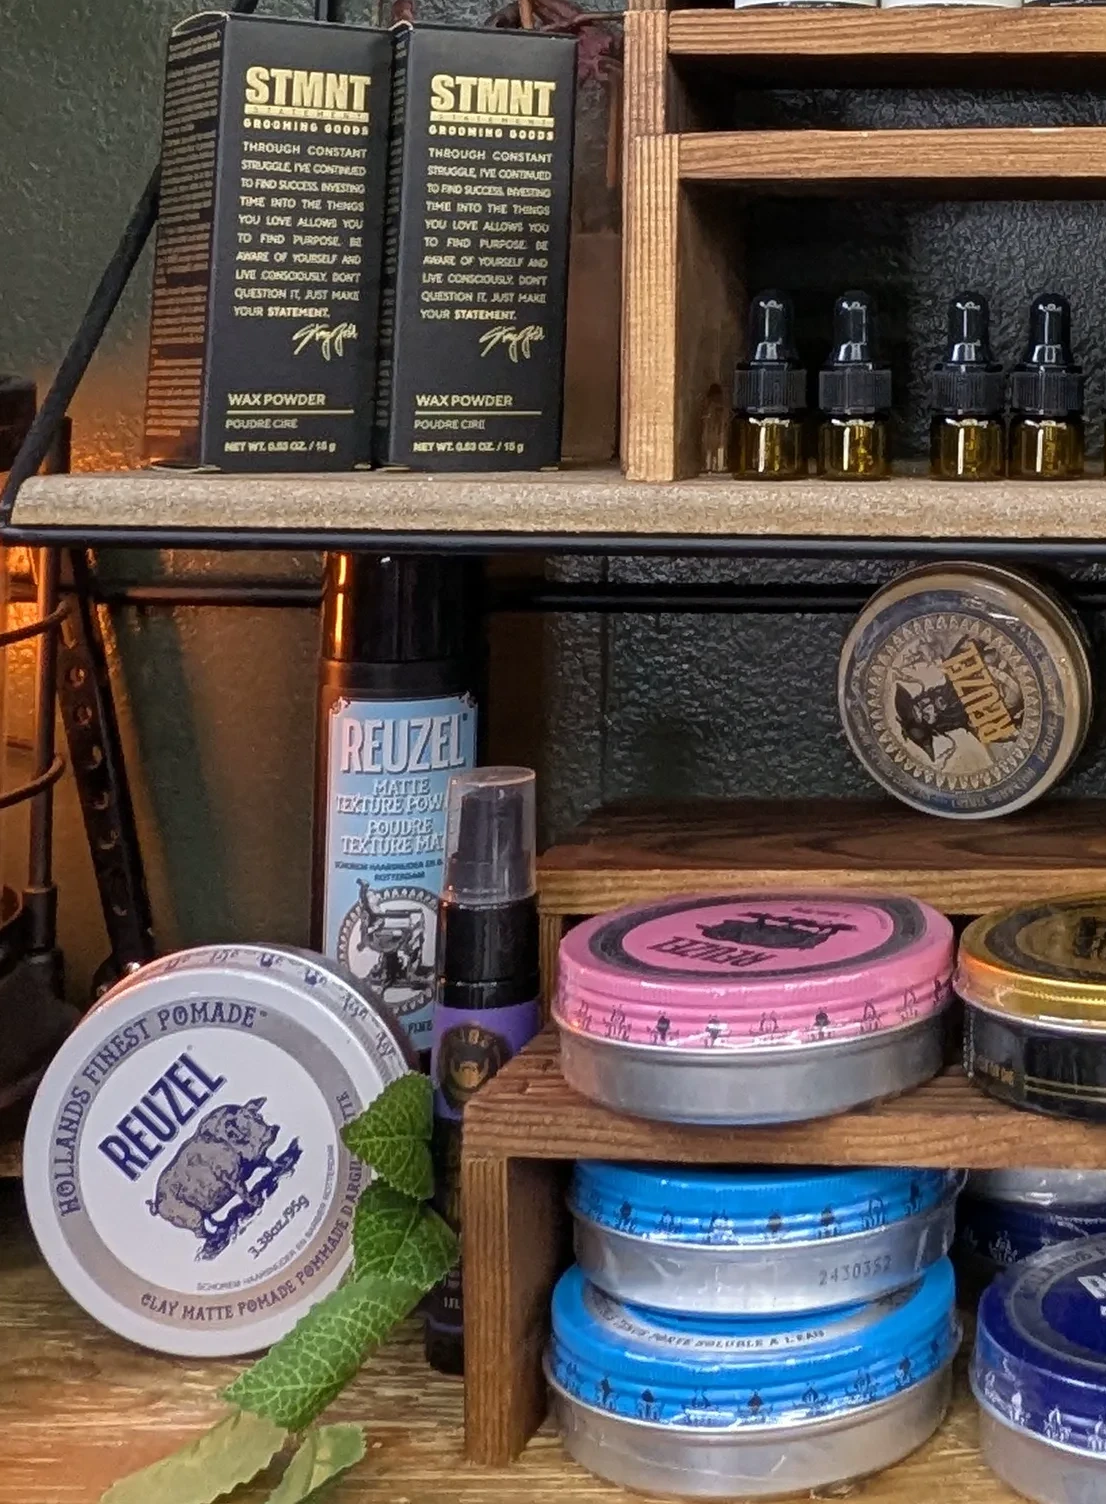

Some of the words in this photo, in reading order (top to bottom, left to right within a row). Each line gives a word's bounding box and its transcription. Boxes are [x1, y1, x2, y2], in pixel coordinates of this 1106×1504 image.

[246, 67, 371, 110] STMNT
[431, 74, 556, 116] STMNT
[243, 118, 318, 132] GROOMING
[324, 124, 368, 135] GOODS
[429, 125, 503, 138] GROOMING
[510, 130, 554, 141] GOODS
[243, 141, 300, 154] THROUGH
[307, 146, 367, 158] CONSTANT
[428, 148, 486, 160] THROUGH
[492, 151, 552, 163] CONSTANT
[313, 164, 366, 176] CONTINUED
[241, 178, 253, 188] TO
[255, 179, 276, 189] FIND
[240, 196, 265, 207] TIME
[271, 198, 296, 208] INTO
[302, 199, 322, 210] THE
[327, 200, 364, 211] THINGS
[239, 214, 260, 224] YOU
[266, 216, 292, 226] LOVE
[298, 217, 337, 228] ALLOWS
[343, 219, 363, 229] YOU
[238, 233, 252, 243] TO
[260, 233, 285, 244] FIND
[236, 252, 269, 262] AWARE
[274, 252, 288, 262] OF
[292, 254, 337, 264] YOURSELF
[342, 255, 361, 265] AND
[236, 269, 256, 280] LIVE
[235, 288, 286, 299] QUESTION
[305, 290, 328, 300] JUST
[332, 291, 360, 301] MAKE
[234, 306, 263, 316] YOUR
[228, 394, 262, 406] WAX
[264, 394, 326, 406] POWDER
[416, 394, 449, 406] WAX
[451, 395, 513, 406] POWDER
[225, 419, 271, 428] POUDRE
[225, 442, 246, 452] NET
[942, 636, 1020, 745] REUZEL
[340, 713, 465, 775] REUZEL
[373, 777, 431, 797] MATTE
[337, 794, 404, 815] TEXTURE
[368, 818, 434, 838] POUDRE
[341, 835, 413, 857] TEXTURE
[646, 936, 778, 967] REUZEL
[54, 1086, 91, 1217] HOLLANDS
[83, 1018, 151, 1086] FINEST
[157, 1002, 257, 1031] POMADE
[98, 1052, 227, 1181] REUZEL
[141, 1294, 179, 1317] CLAY
[181, 1305, 234, 1321] MATTE
[237, 1280, 297, 1316] POMADE
[297, 1219, 349, 1285] POMMADE
